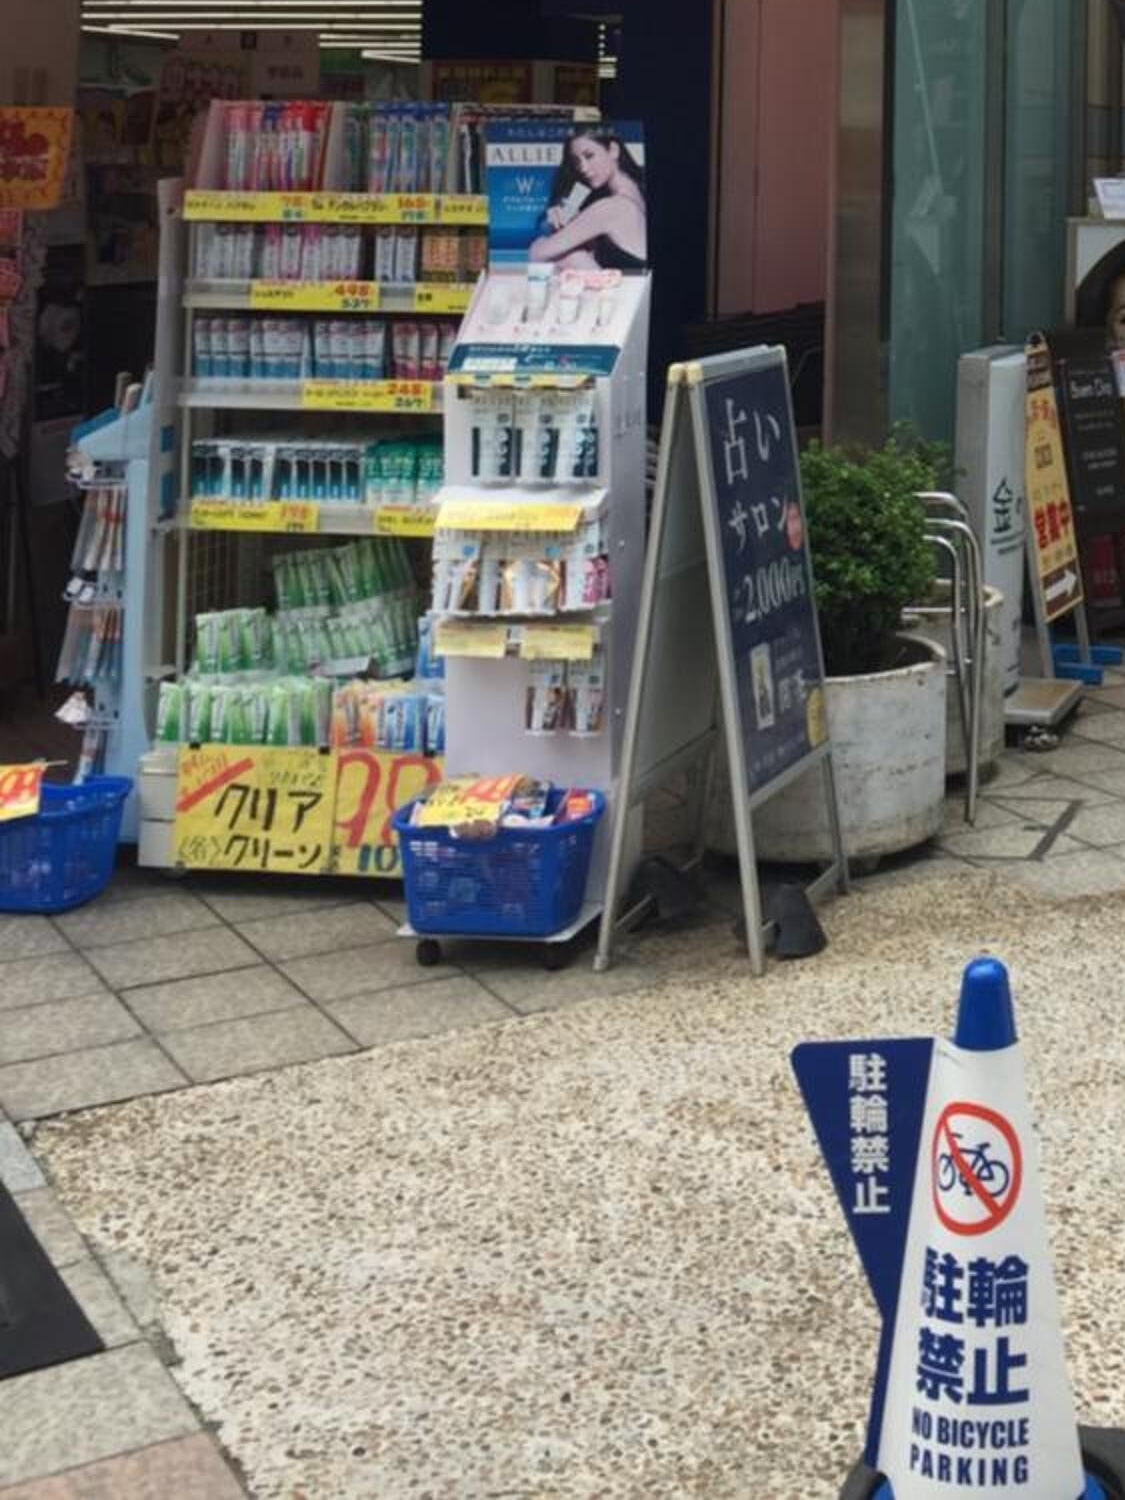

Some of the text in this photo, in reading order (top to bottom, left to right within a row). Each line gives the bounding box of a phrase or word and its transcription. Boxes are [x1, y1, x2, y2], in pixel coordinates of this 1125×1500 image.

[492, 147, 557, 162] ALLIE
[723, 398, 782, 485] 占い
[213, 783, 324, 834] クリア
[224, 834, 323, 869] クリーン
[847, 1052, 891, 1216] 駐輪禁止
[924, 1246, 1029, 1329] 駐輪
[915, 1326, 1029, 1406] 禁止
[911, 1407, 1030, 1450] NO BICYCLE
[909, 1444, 1030, 1488] PARKING
